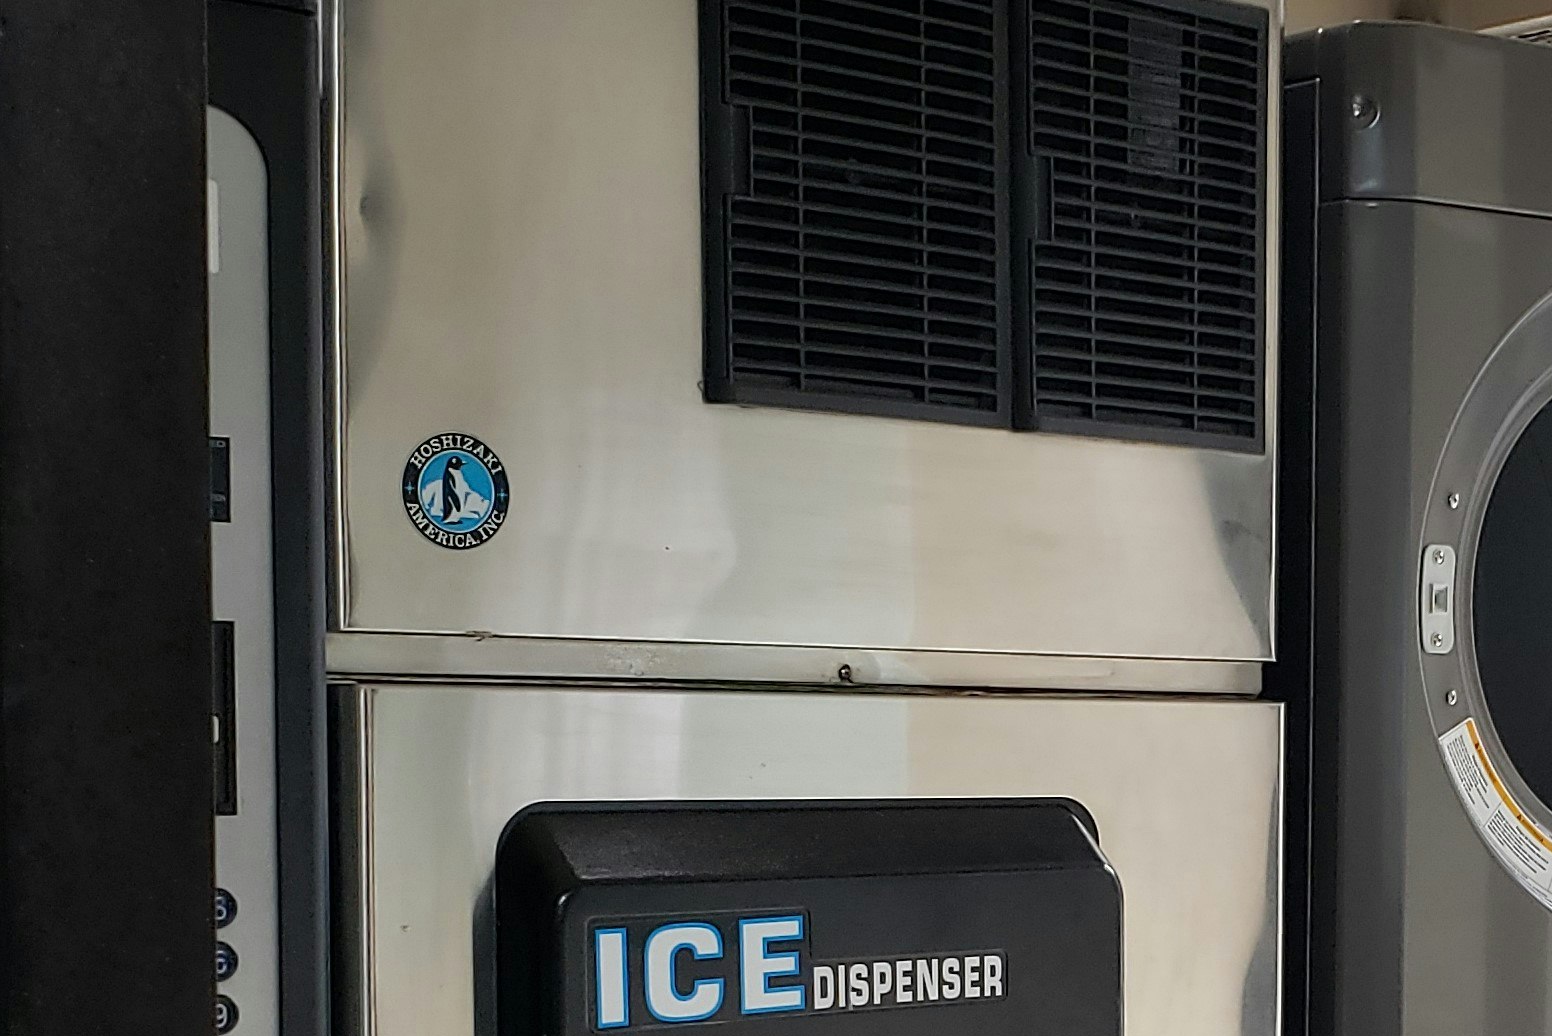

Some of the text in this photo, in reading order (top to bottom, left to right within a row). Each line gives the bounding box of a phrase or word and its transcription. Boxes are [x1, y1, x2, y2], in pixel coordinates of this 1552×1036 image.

[410, 435, 502, 475] HOSHIZAKI
[595, 915, 1003, 1030] ICE DISPENSER
